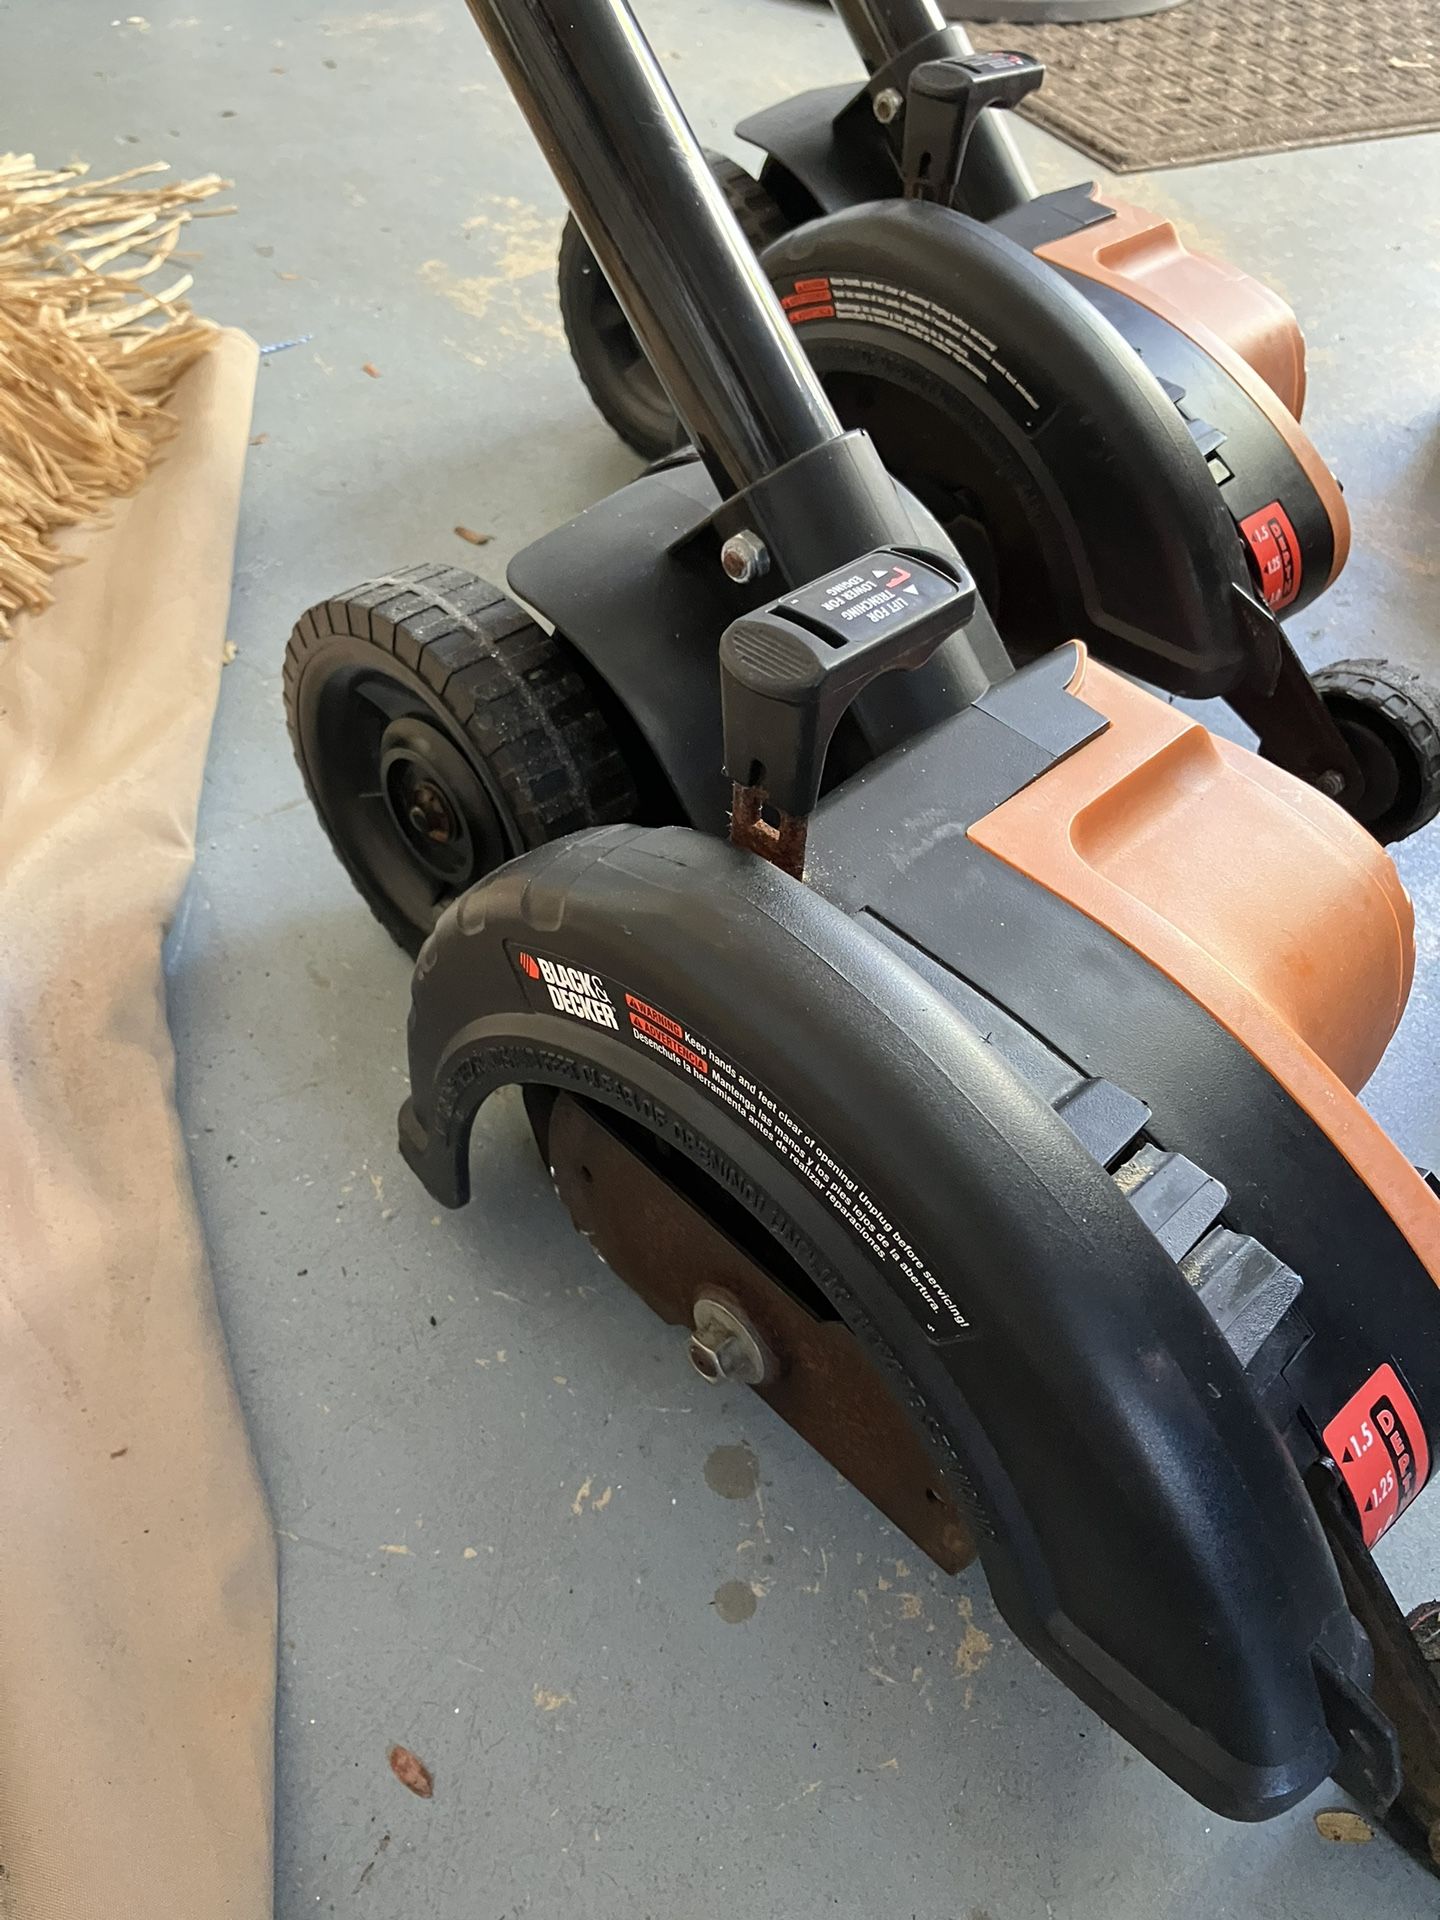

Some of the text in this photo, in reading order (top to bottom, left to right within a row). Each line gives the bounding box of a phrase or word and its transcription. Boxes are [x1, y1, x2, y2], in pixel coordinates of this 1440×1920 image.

[1254, 525, 1269, 543] 1.5
[821, 580, 877, 611] LOWER FOR
[826, 575, 864, 596] EDGING
[841, 589, 896, 620] TRENCHING
[866, 597, 909, 622] LIFT FOR
[547, 984, 619, 1031] DECKER
[632, 1027, 886, 1262] Desenchufe la herramienta antes de realizar reparaciones.
[638, 1003, 970, 1327] WARNING Keep hands and feet clear of opening! Unplug before servicing!
[644, 1022, 939, 1314] ADVERTENCIA Mantenga las manos y los pies lejos de la abertura.
[1350, 1421, 1374, 1458] 1.5
[1371, 1469, 1394, 1508] 1.25
